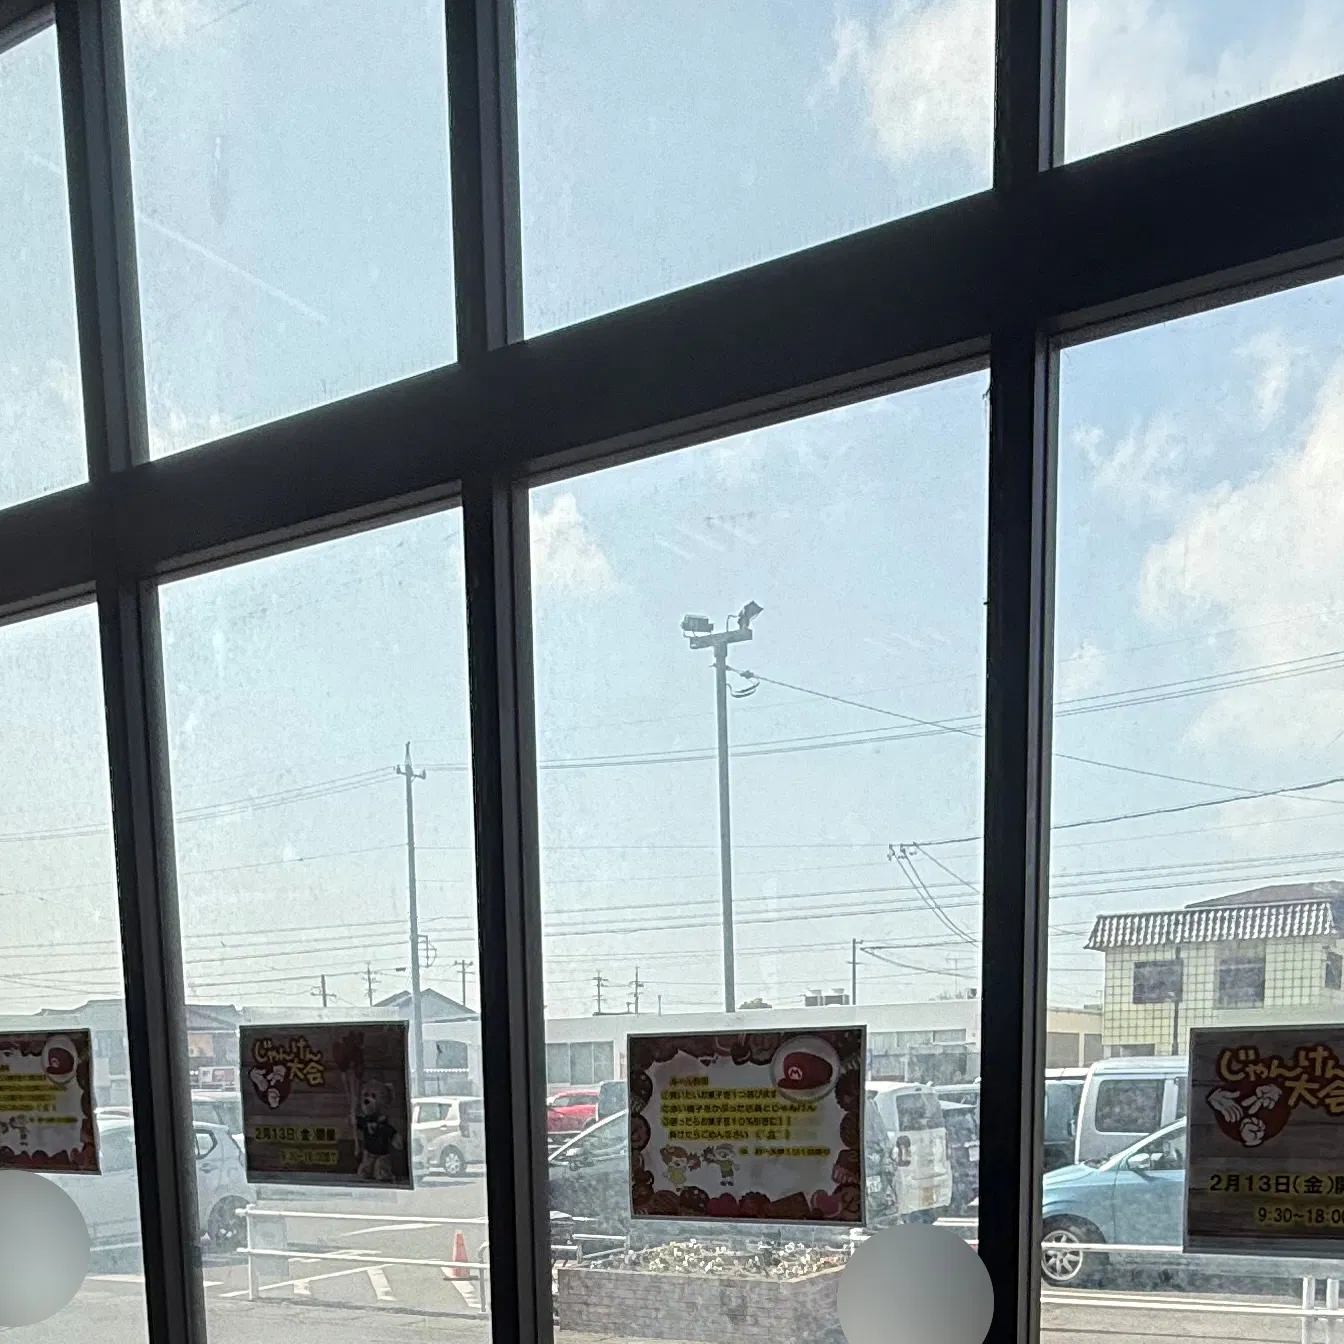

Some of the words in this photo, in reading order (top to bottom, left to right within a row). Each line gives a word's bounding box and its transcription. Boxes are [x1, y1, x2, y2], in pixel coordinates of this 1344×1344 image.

[255, 1037, 322, 1063] じゃんけん
[289, 1061, 325, 1086] 大会
